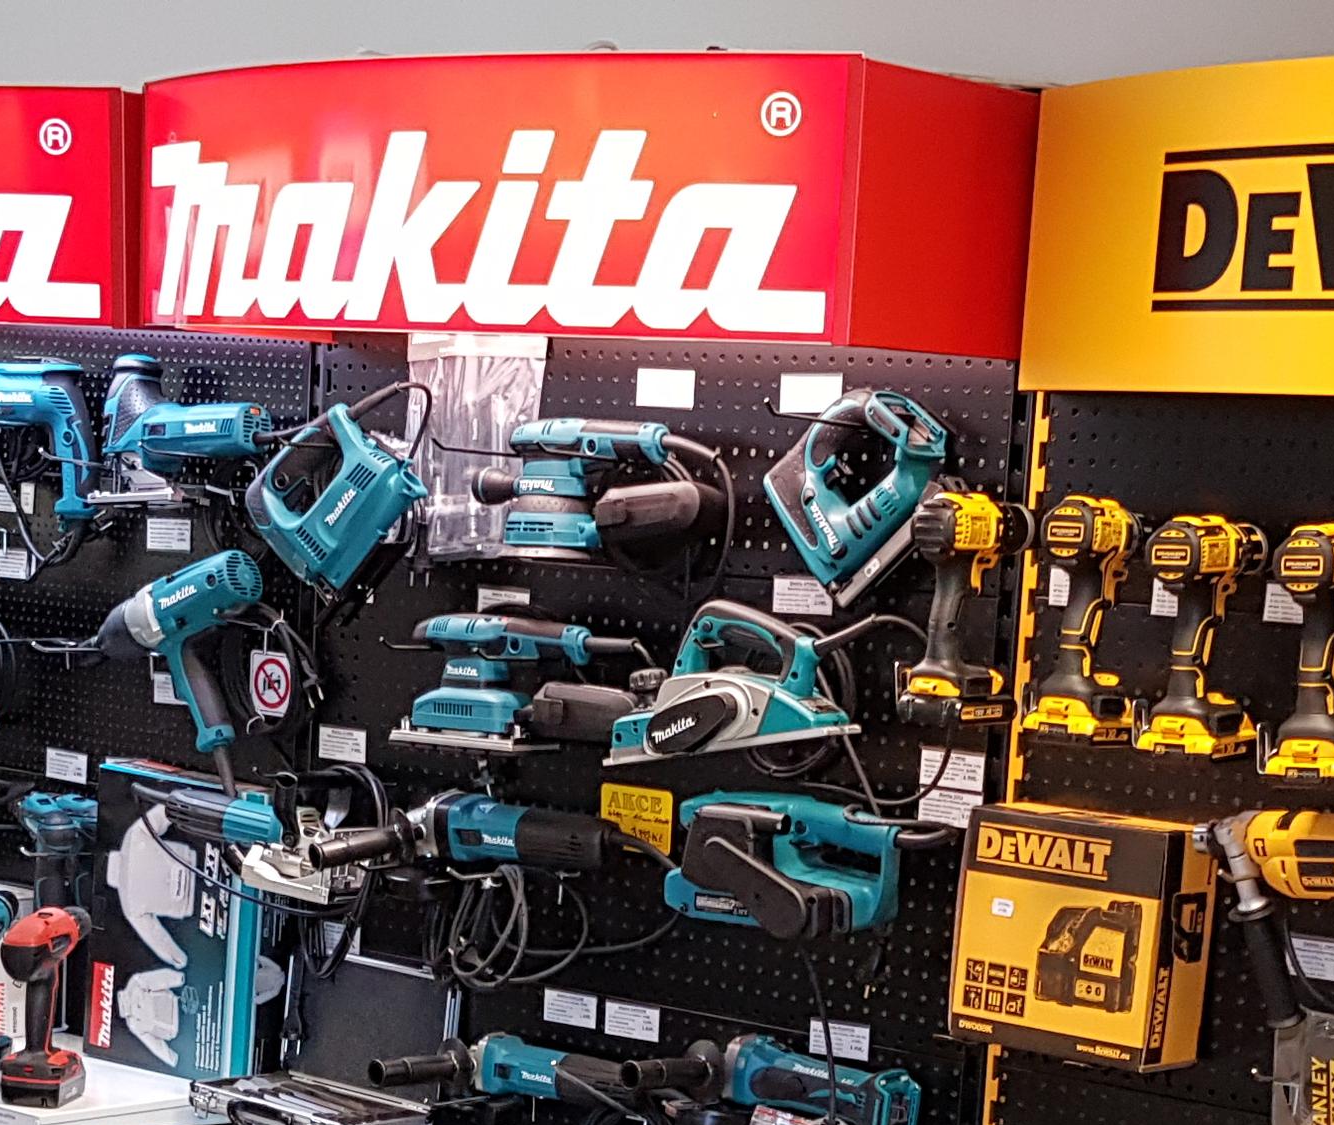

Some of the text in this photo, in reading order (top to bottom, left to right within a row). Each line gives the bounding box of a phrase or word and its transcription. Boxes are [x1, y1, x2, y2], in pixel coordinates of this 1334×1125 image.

[151, 129, 826, 333] makita
[324, 487, 357, 526] makita
[810, 501, 842, 549] makita
[158, 585, 197, 610] makita
[652, 717, 695, 743] makita
[608, 791, 662, 814] AKCE
[482, 834, 515, 847] makita
[978, 827, 1111, 876] DEWALT
[99, 965, 114, 1048] makita
[1150, 968, 1170, 1048] DEWALT
